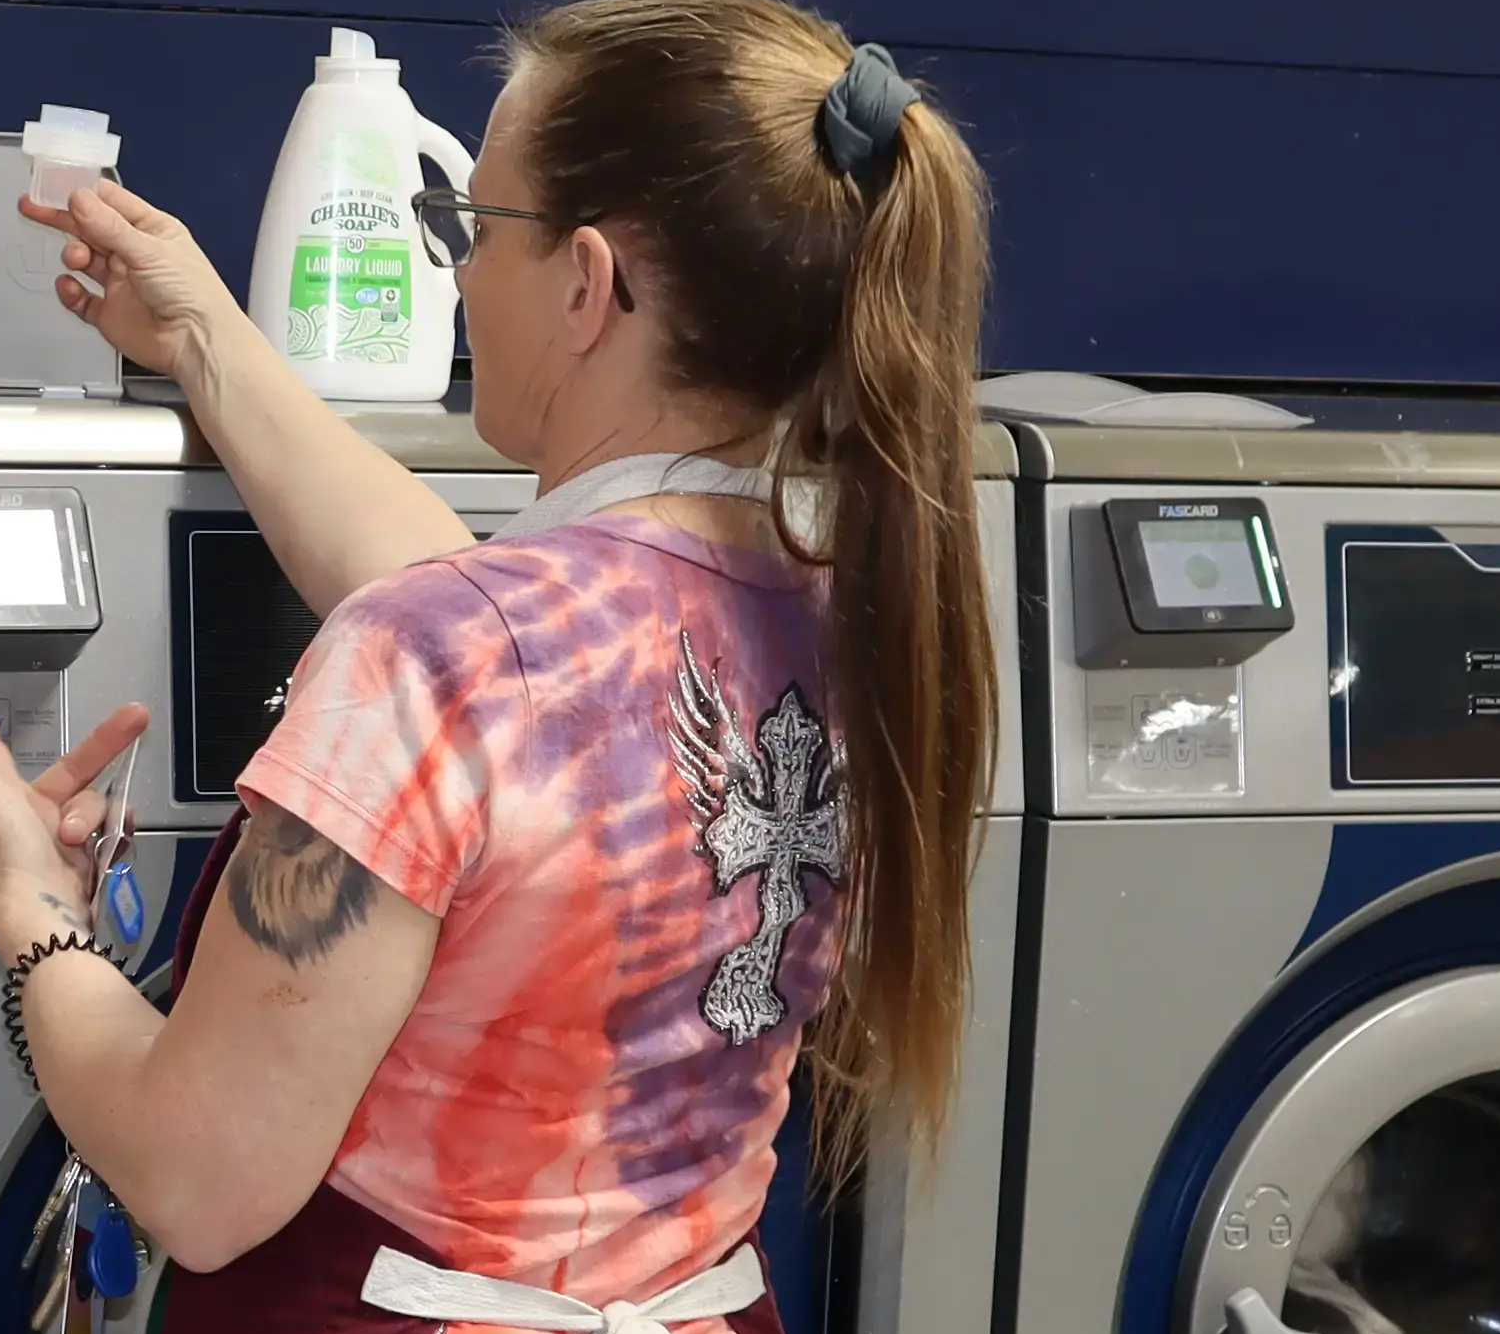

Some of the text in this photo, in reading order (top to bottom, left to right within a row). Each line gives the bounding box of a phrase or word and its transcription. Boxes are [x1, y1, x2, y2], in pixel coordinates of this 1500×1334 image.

[311, 202, 399, 229] CHARLIE'S
[334, 218, 378, 231] SOAP
[348, 237, 363, 250] 50
[305, 256, 402, 276] LAUDRY LIQUID
[1158, 504, 1219, 517] FASCARD
